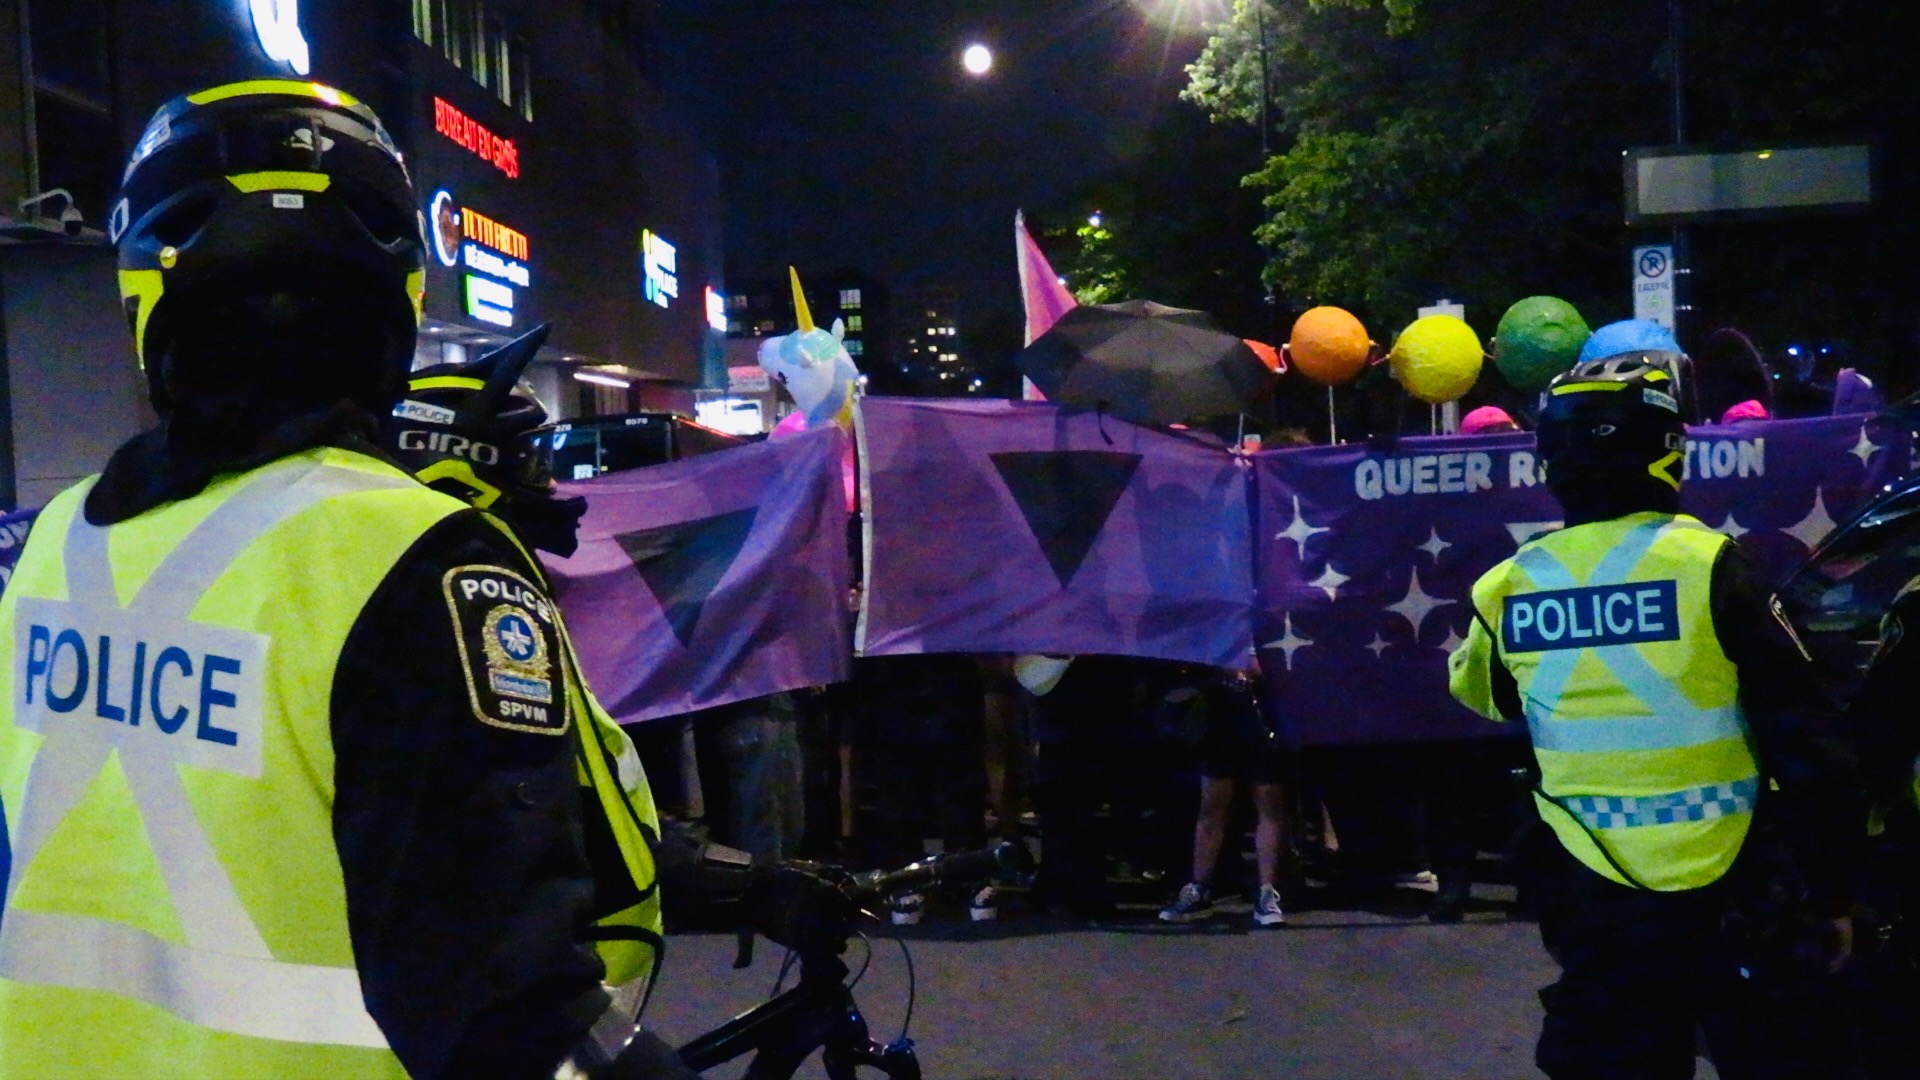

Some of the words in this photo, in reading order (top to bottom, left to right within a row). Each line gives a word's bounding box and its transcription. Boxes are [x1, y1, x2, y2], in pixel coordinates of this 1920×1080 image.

[434, 96, 477, 152] BUREAU
[478, 125, 492, 160] EN
[407, 404, 451, 424] POLICE
[398, 430, 499, 465] GIRO
[1355, 451, 1493, 500] QUEER
[460, 578, 552, 624] POLICE
[1511, 588, 1665, 644] POLICE
[26, 624, 241, 747] POLICE
[498, 700, 548, 723] SPVM
